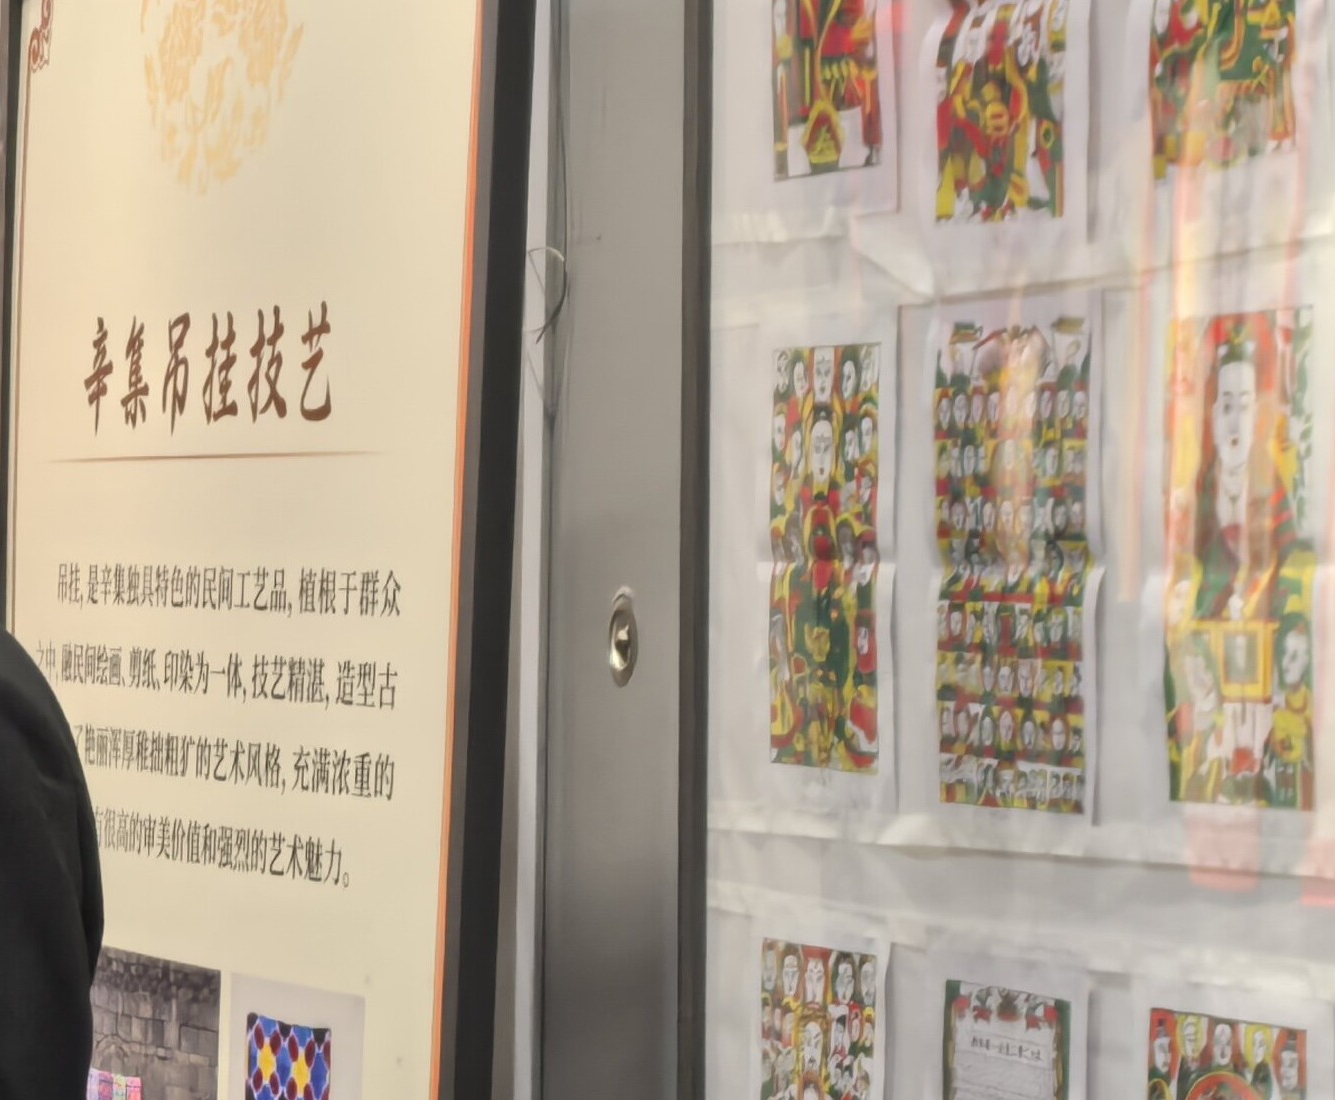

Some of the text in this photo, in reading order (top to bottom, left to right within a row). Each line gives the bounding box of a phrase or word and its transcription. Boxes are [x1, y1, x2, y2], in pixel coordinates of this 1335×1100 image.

[83, 301, 332, 437] 辛集吊挂技艺
